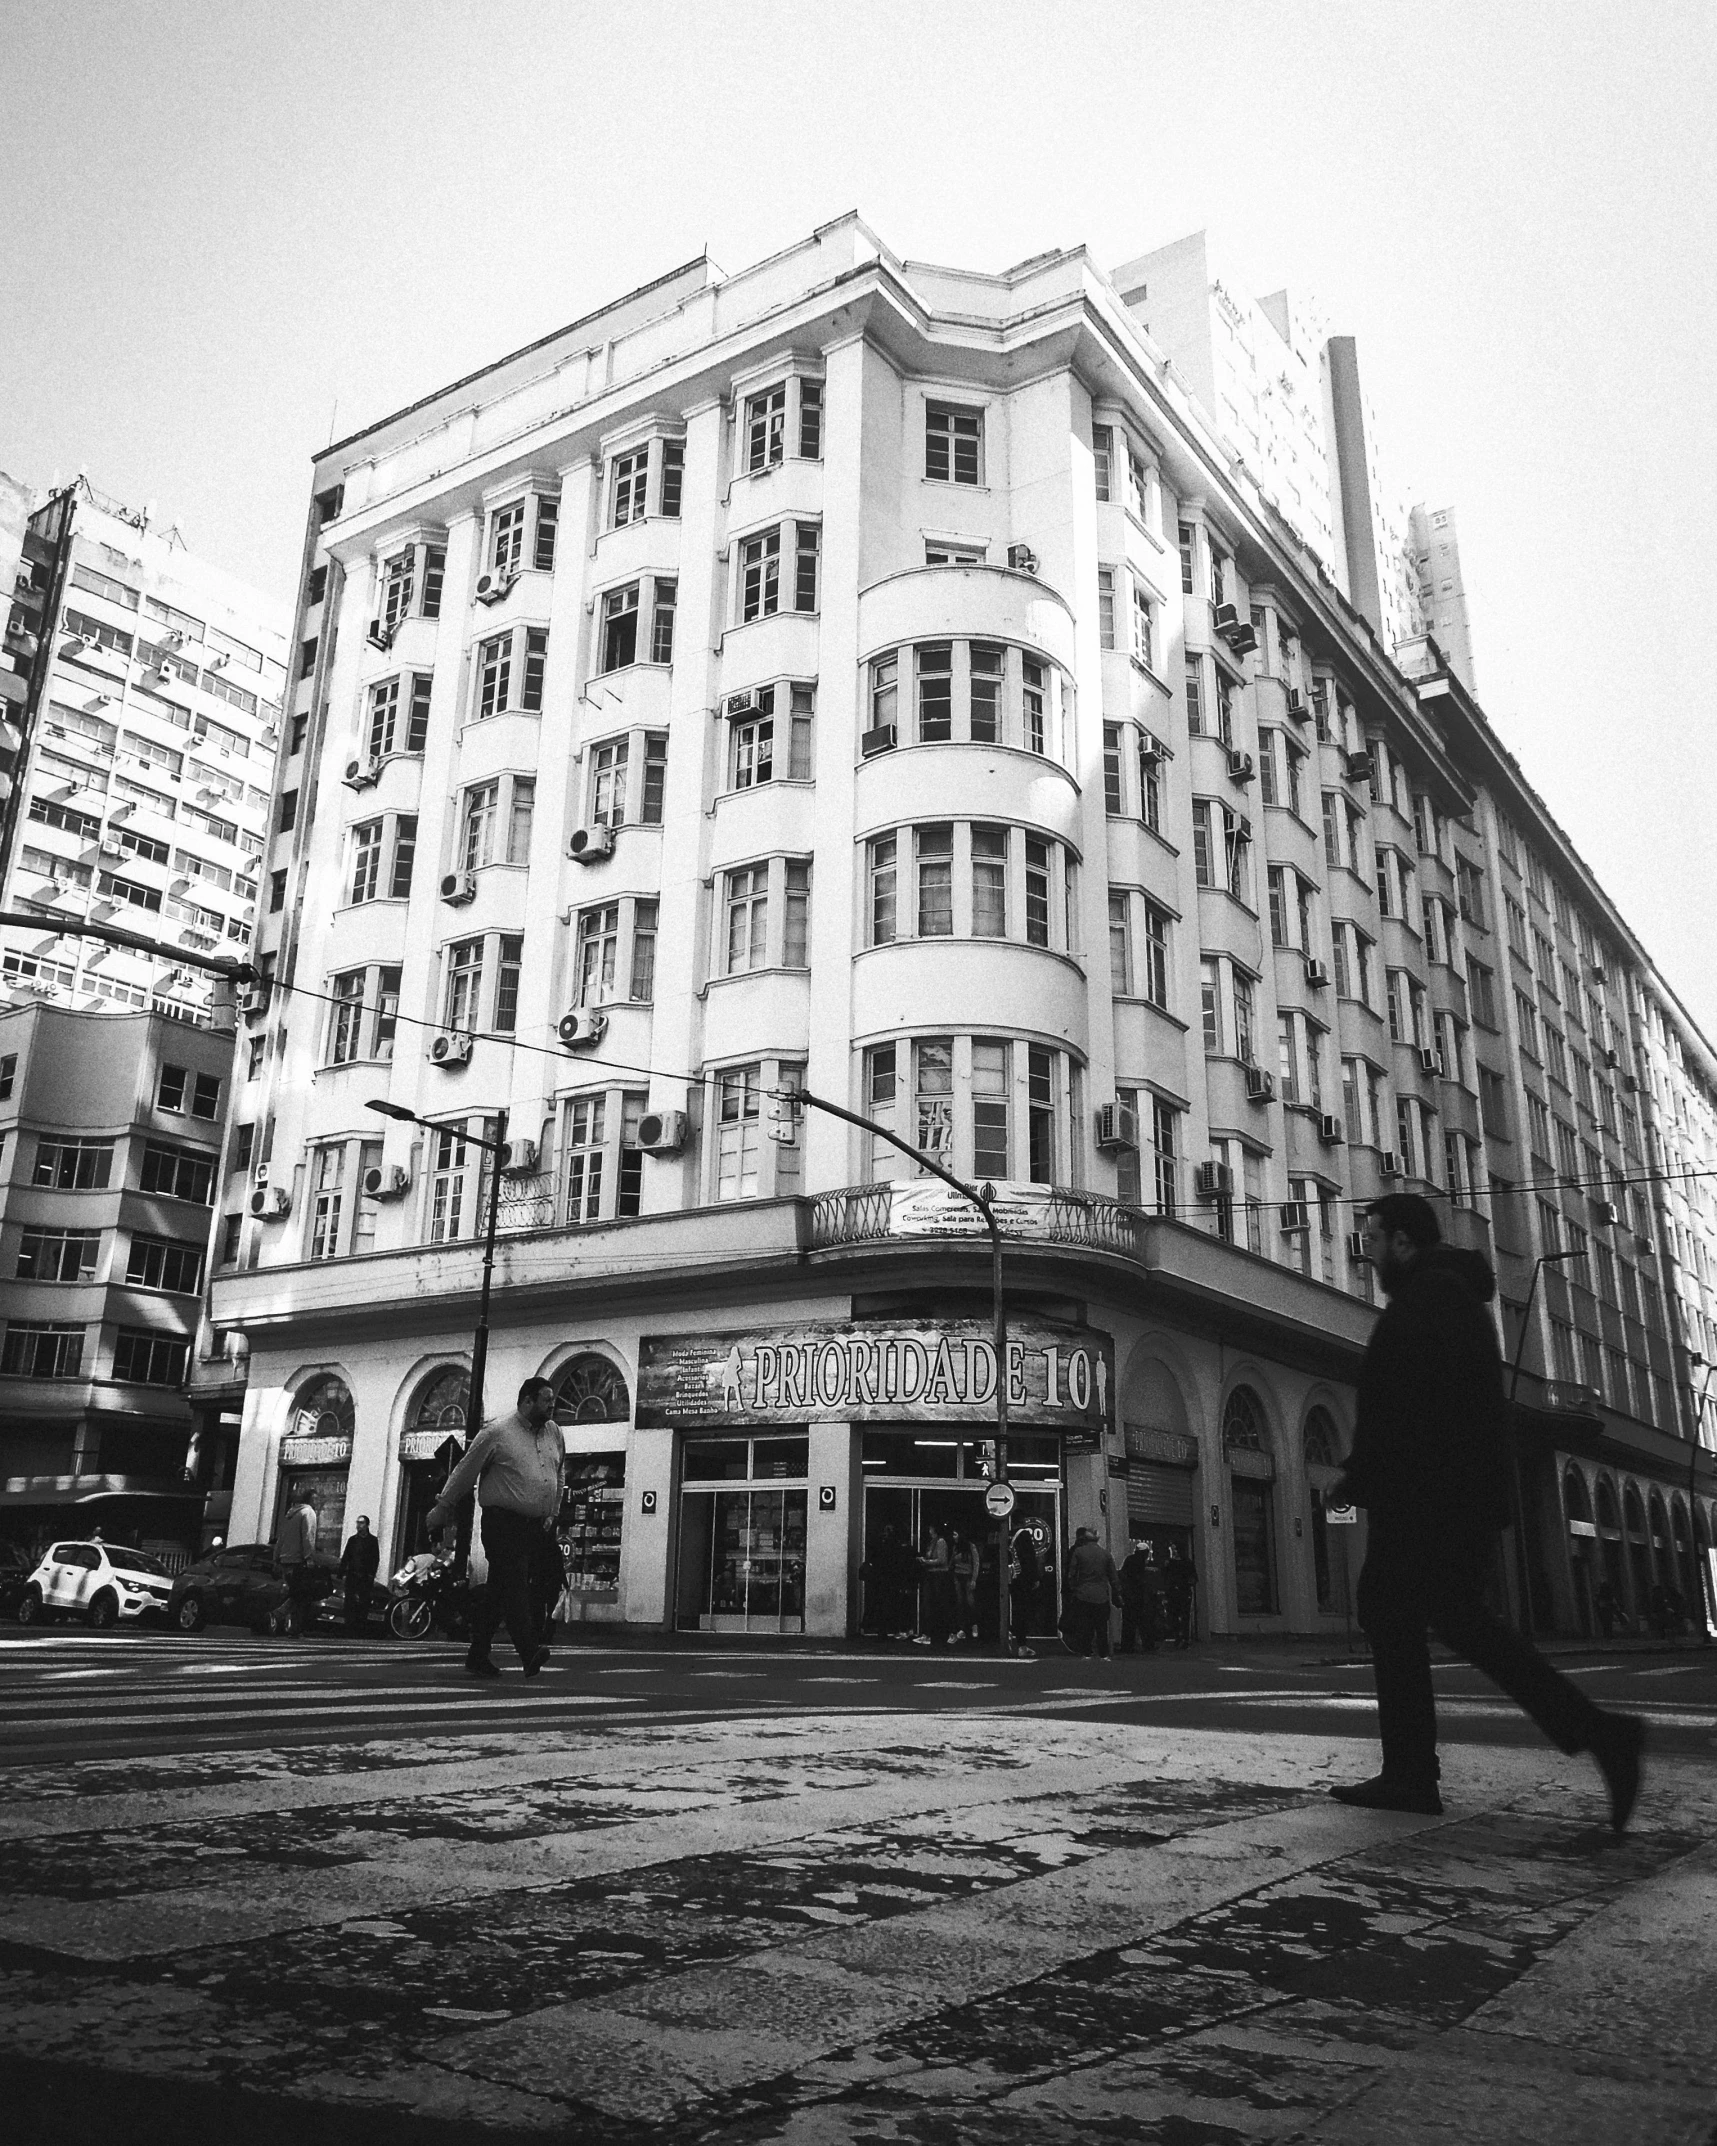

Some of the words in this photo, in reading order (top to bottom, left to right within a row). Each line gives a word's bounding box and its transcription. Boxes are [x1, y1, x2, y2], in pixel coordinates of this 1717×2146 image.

[679, 1357, 708, 1365] Masculina
[752, 1337, 1027, 1409] PRIORIDADE
[1042, 1346, 1091, 1410] 10
[675, 1391, 709, 1399] Brinquedos
[682, 1407, 698, 1415] Mesa
